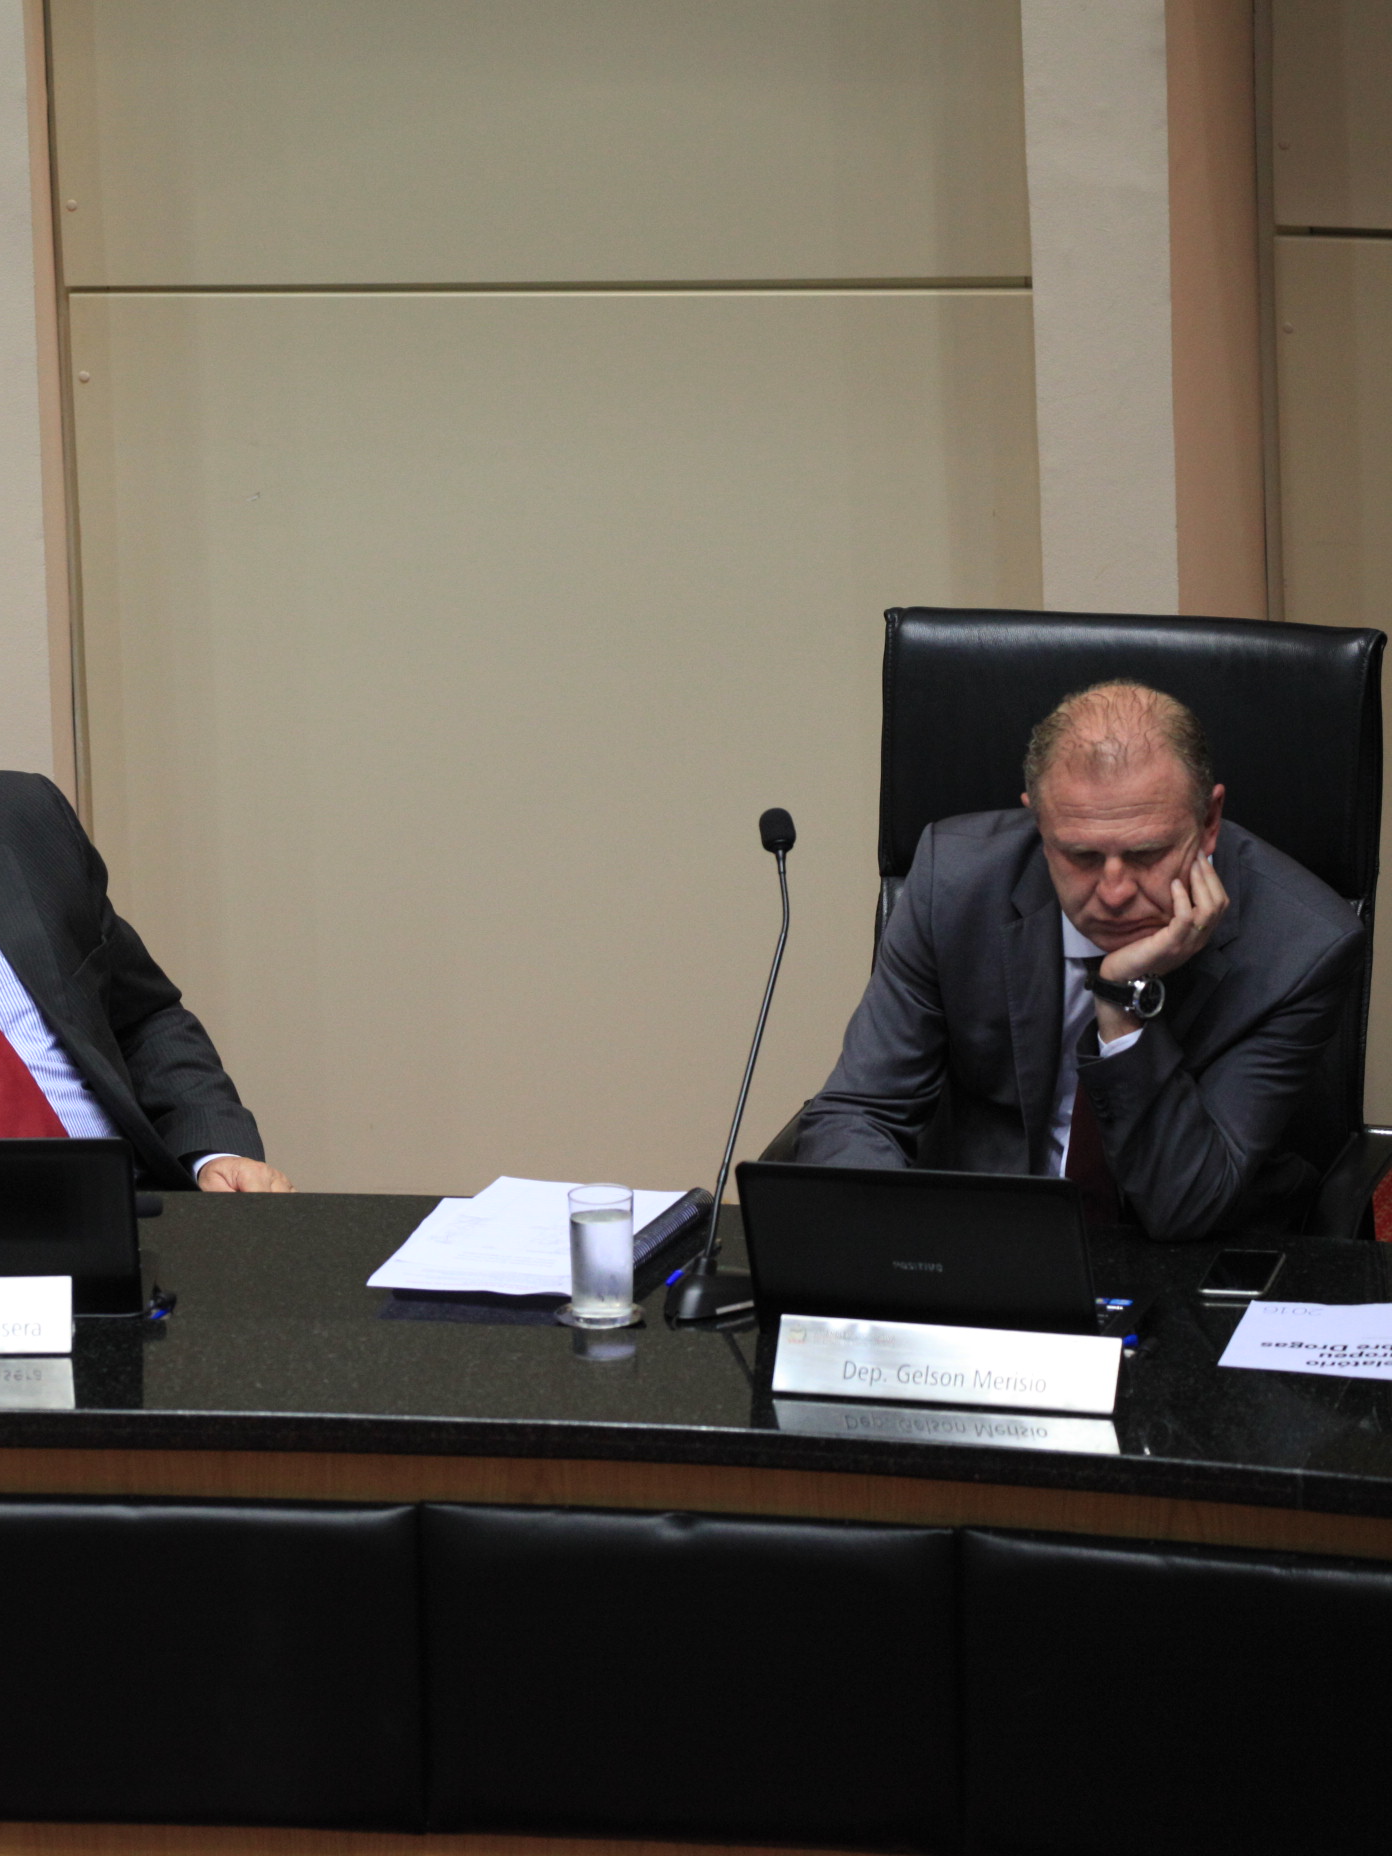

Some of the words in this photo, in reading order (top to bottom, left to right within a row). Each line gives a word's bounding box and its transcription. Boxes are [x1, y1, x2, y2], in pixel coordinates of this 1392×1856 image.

[1260, 1341, 1348, 1351] Drogas
[1319, 1351, 1392, 1359] ropeu
[843, 1360, 887, 1385] Dep.
[896, 1364, 965, 1388] Gelson
[974, 1370, 1048, 1394] Merisio
